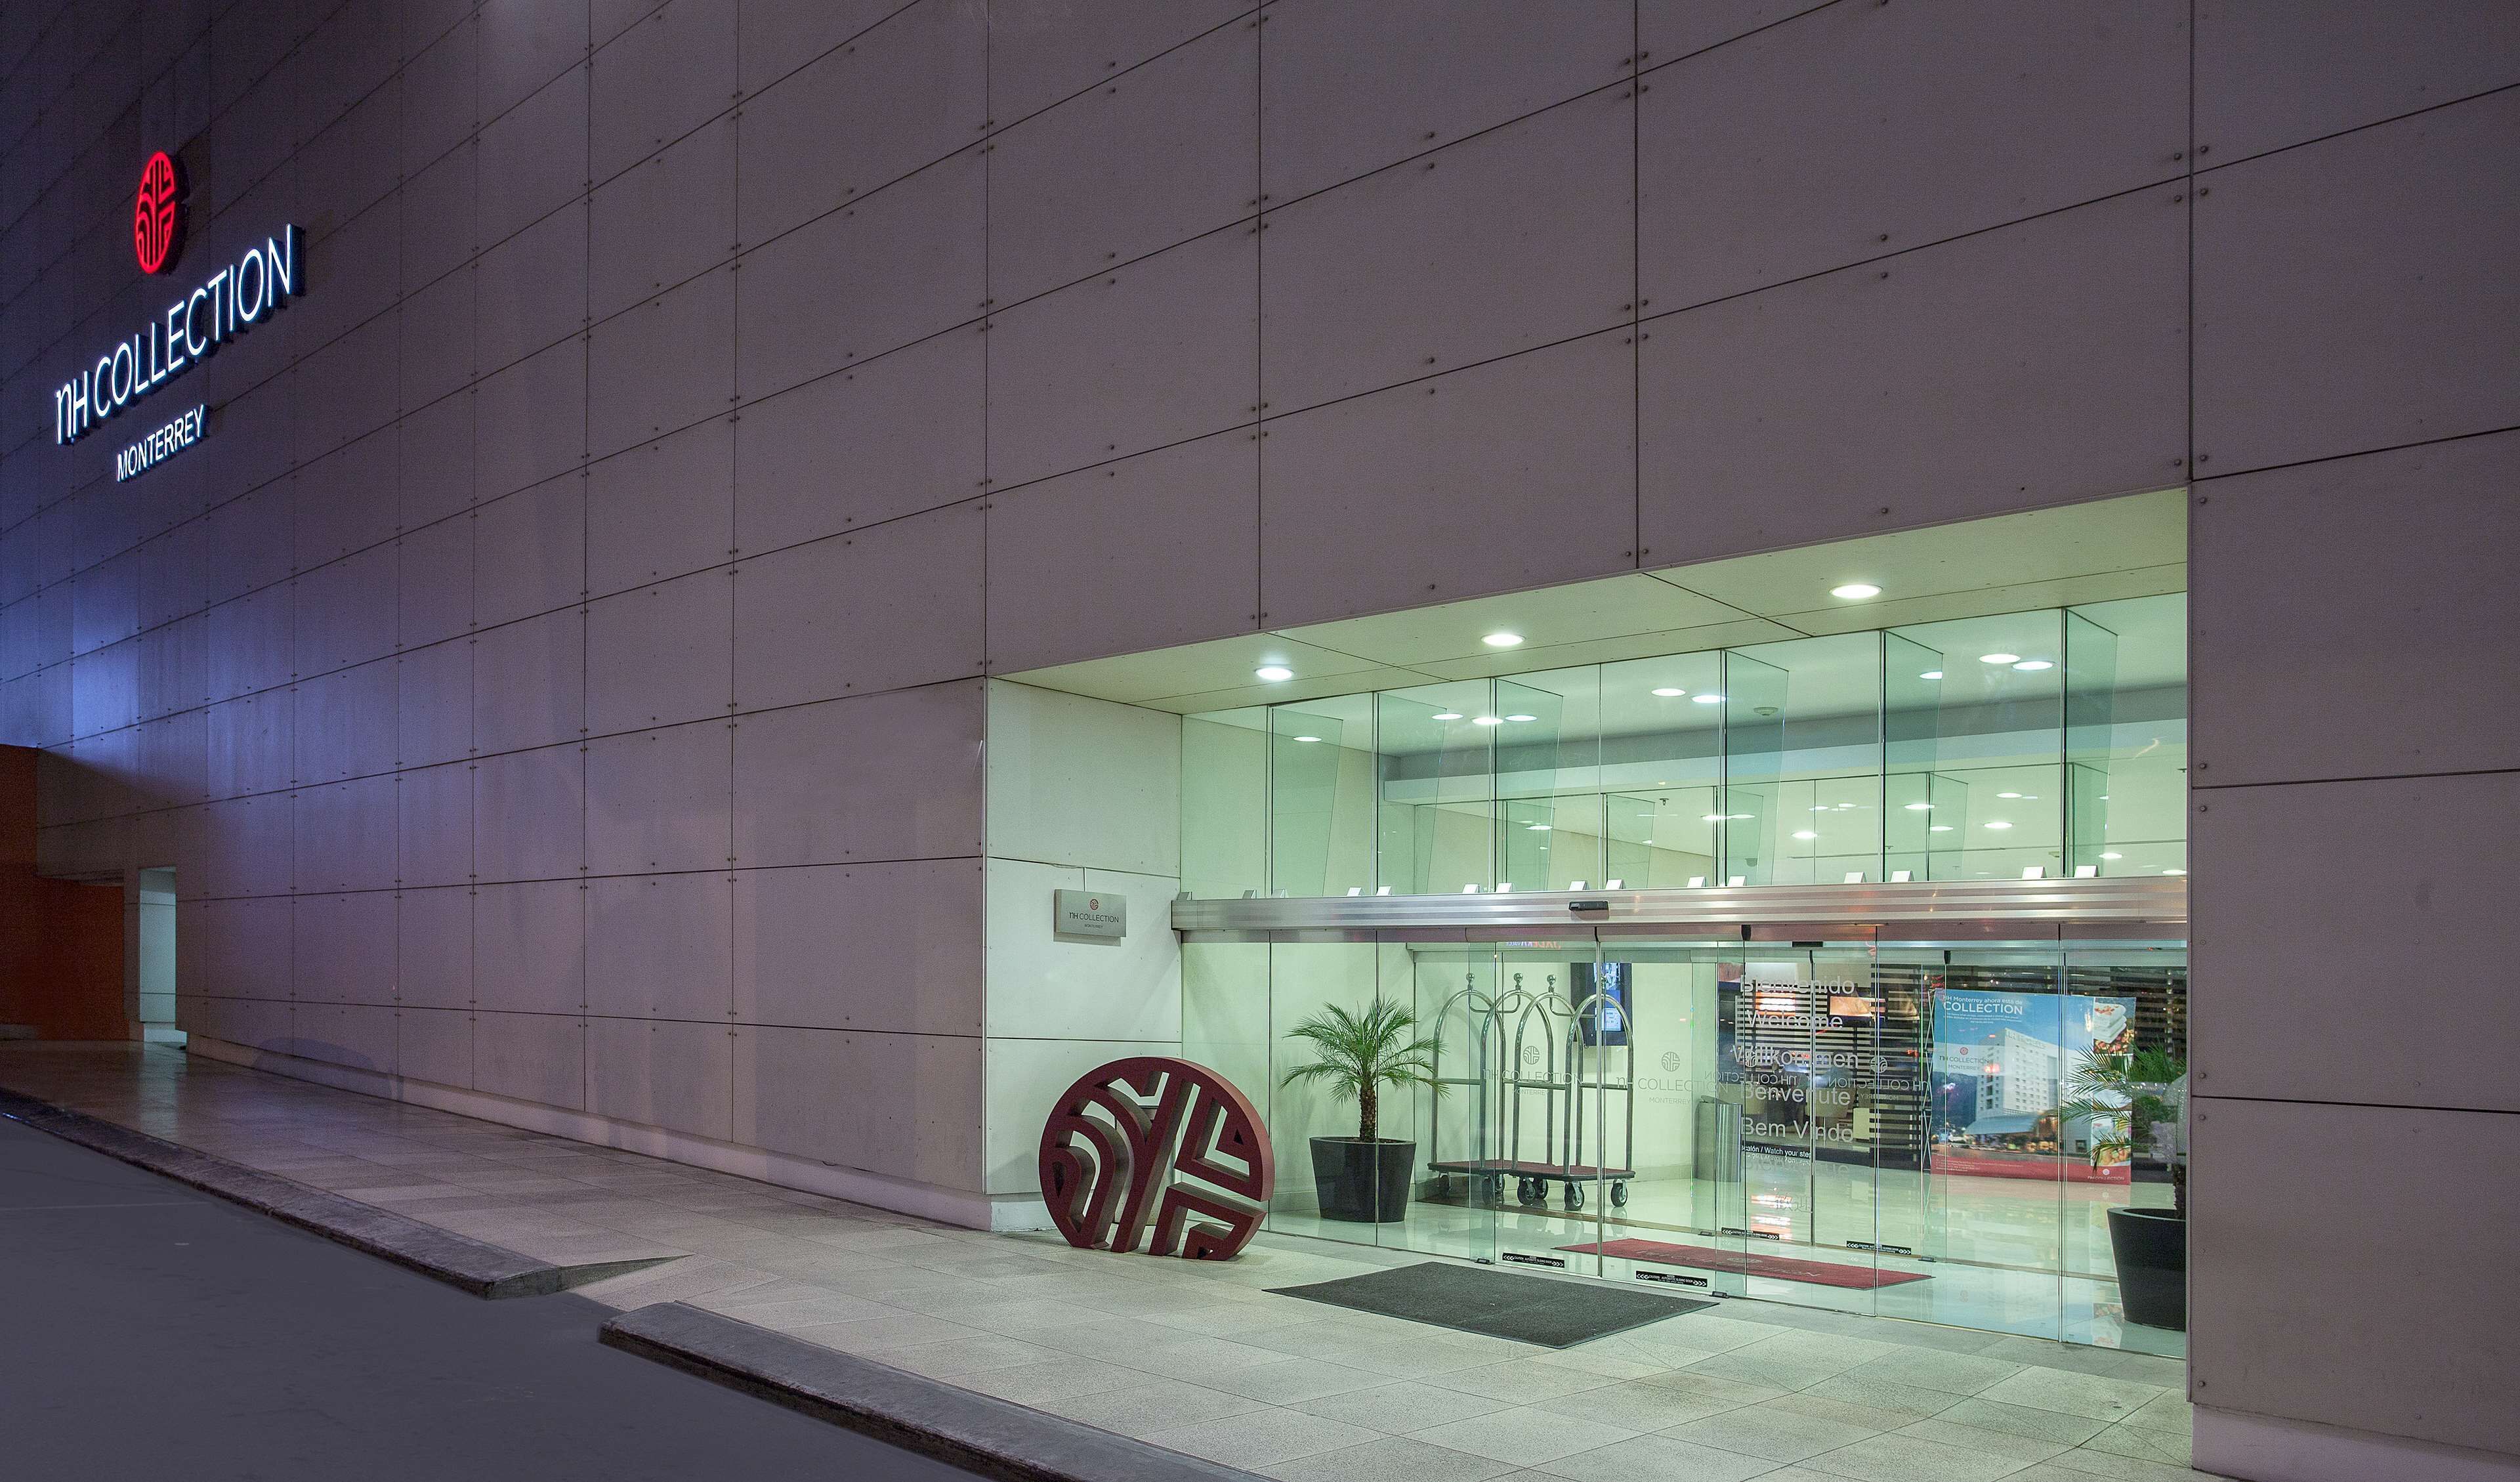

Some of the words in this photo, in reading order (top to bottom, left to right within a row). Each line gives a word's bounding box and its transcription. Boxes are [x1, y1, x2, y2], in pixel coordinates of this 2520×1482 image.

[94, 223, 292, 417] COLLECTION
[117, 404, 205, 482] MONTERREY
[1080, 913, 1119, 923] COLLECTION
[1943, 1001, 2023, 1015] COLLECTION
[1746, 1009, 1843, 1029] Welcome
[1502, 1070, 1583, 1085] COLLECTION
[1638, 1078, 1728, 1094] COLLECTION
[1649, 1097, 1691, 1105] MONTERREY
[1740, 1117, 1786, 1137] Bem
[1764, 1147, 1783, 1155] Watch
